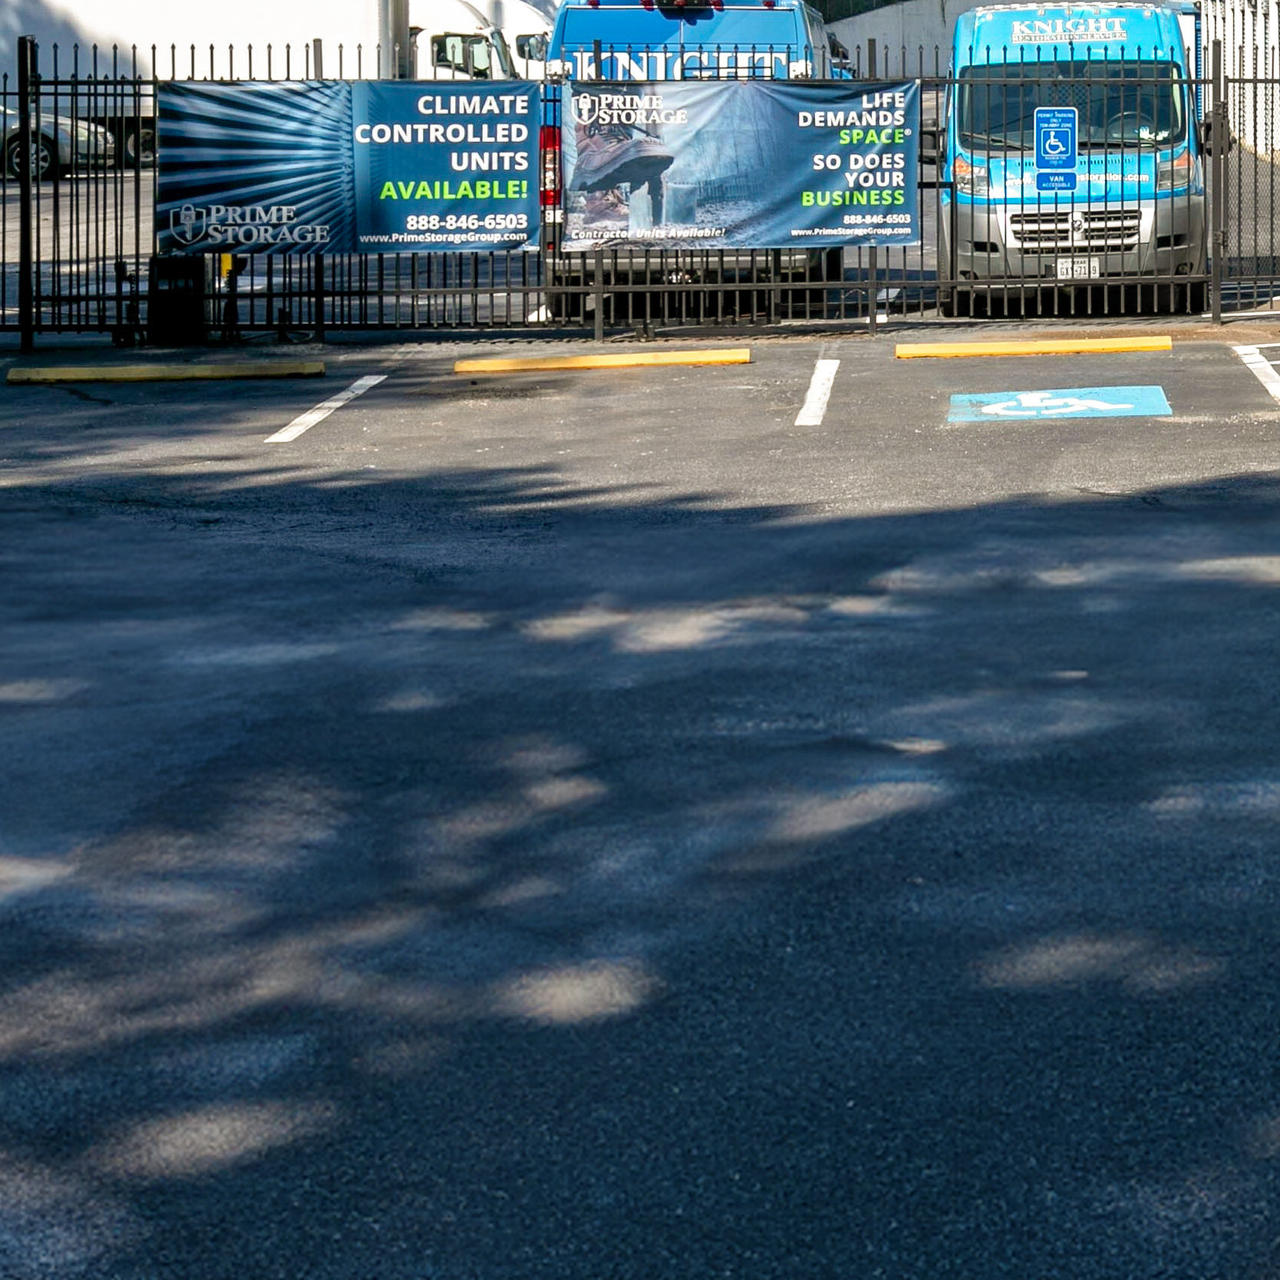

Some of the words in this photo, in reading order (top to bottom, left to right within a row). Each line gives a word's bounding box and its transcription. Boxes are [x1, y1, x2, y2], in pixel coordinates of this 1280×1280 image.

[1012, 18, 1127, 34] KNIGHT
[573, 52, 788, 81] KNIGHT
[417, 95, 529, 115] CLIMATE
[599, 94, 664, 110] PRIME
[862, 92, 905, 109] LIFE
[599, 109, 688, 124] STORAGE
[798, 111, 905, 127] DEMANDS
[355, 123, 529, 144] CONTROLLED
[451, 152, 529, 171] UNITS
[813, 154, 842, 170] SO
[849, 153, 905, 170] DOES
[845, 171, 905, 188] YOUR
[379, 180, 528, 200] AVAILABLE!
[801, 190, 905, 207] BUSINESS
[207, 205, 297, 224] PRIME
[406, 214, 528, 230] 888-846-6503
[843, 214, 912, 224] 888-846-6503
[207, 225, 331, 244] STORAGE
[360, 232, 528, 244] www.PrimeStorageGroup.com
[571, 229, 633, 240] Contractor
[636, 228, 667, 238] Units
[669, 227, 726, 238] Available!
[791, 226, 912, 237] www.PrimeStorageGroup.com
